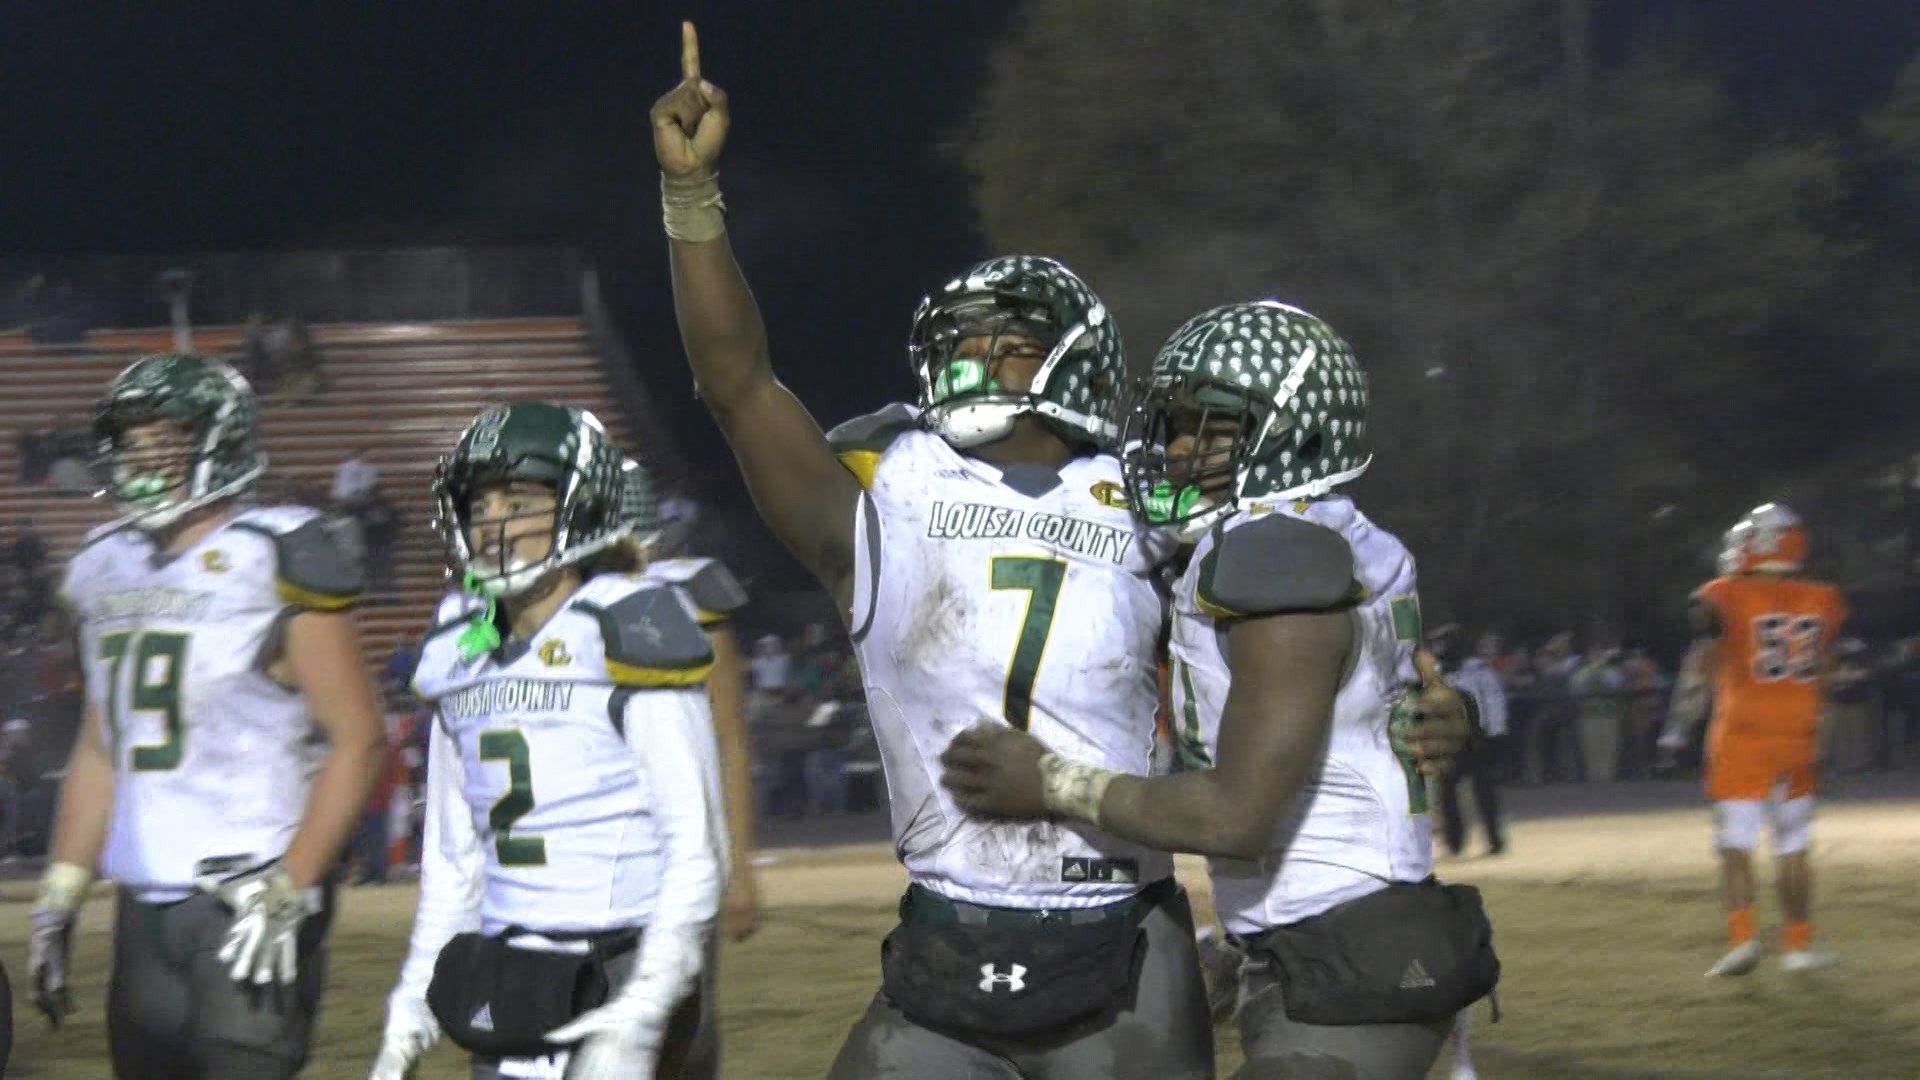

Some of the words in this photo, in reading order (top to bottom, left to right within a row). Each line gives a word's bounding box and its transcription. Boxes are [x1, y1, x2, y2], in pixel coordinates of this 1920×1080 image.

[928, 501, 1024, 539] LOUISA
[1027, 511, 1134, 566] COUNTY
[988, 555, 1069, 733] 7
[493, 679, 574, 713] COUNTY
[478, 728, 547, 867] 2
